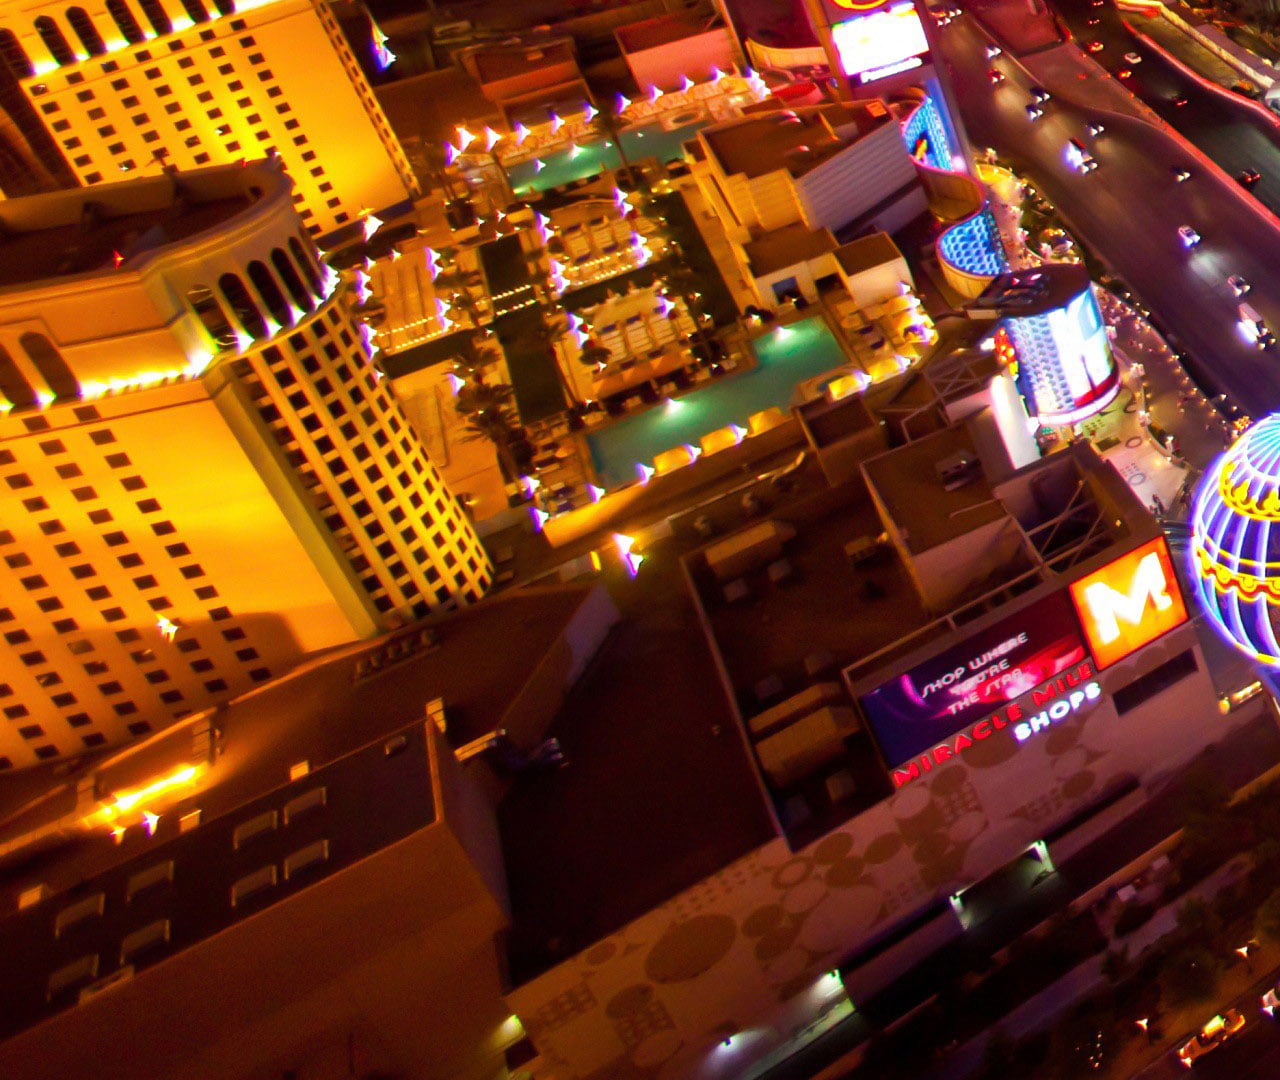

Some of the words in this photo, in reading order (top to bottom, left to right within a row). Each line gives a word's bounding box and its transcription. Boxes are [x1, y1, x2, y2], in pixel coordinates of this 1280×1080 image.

[922, 666, 966, 699] SHOP
[969, 631, 1029, 670] WHERE
[893, 703, 1023, 788] MIRACLE
[1032, 662, 1093, 708] MILE
[946, 691, 981, 715] THE
[1014, 682, 1102, 742] SHOPS
